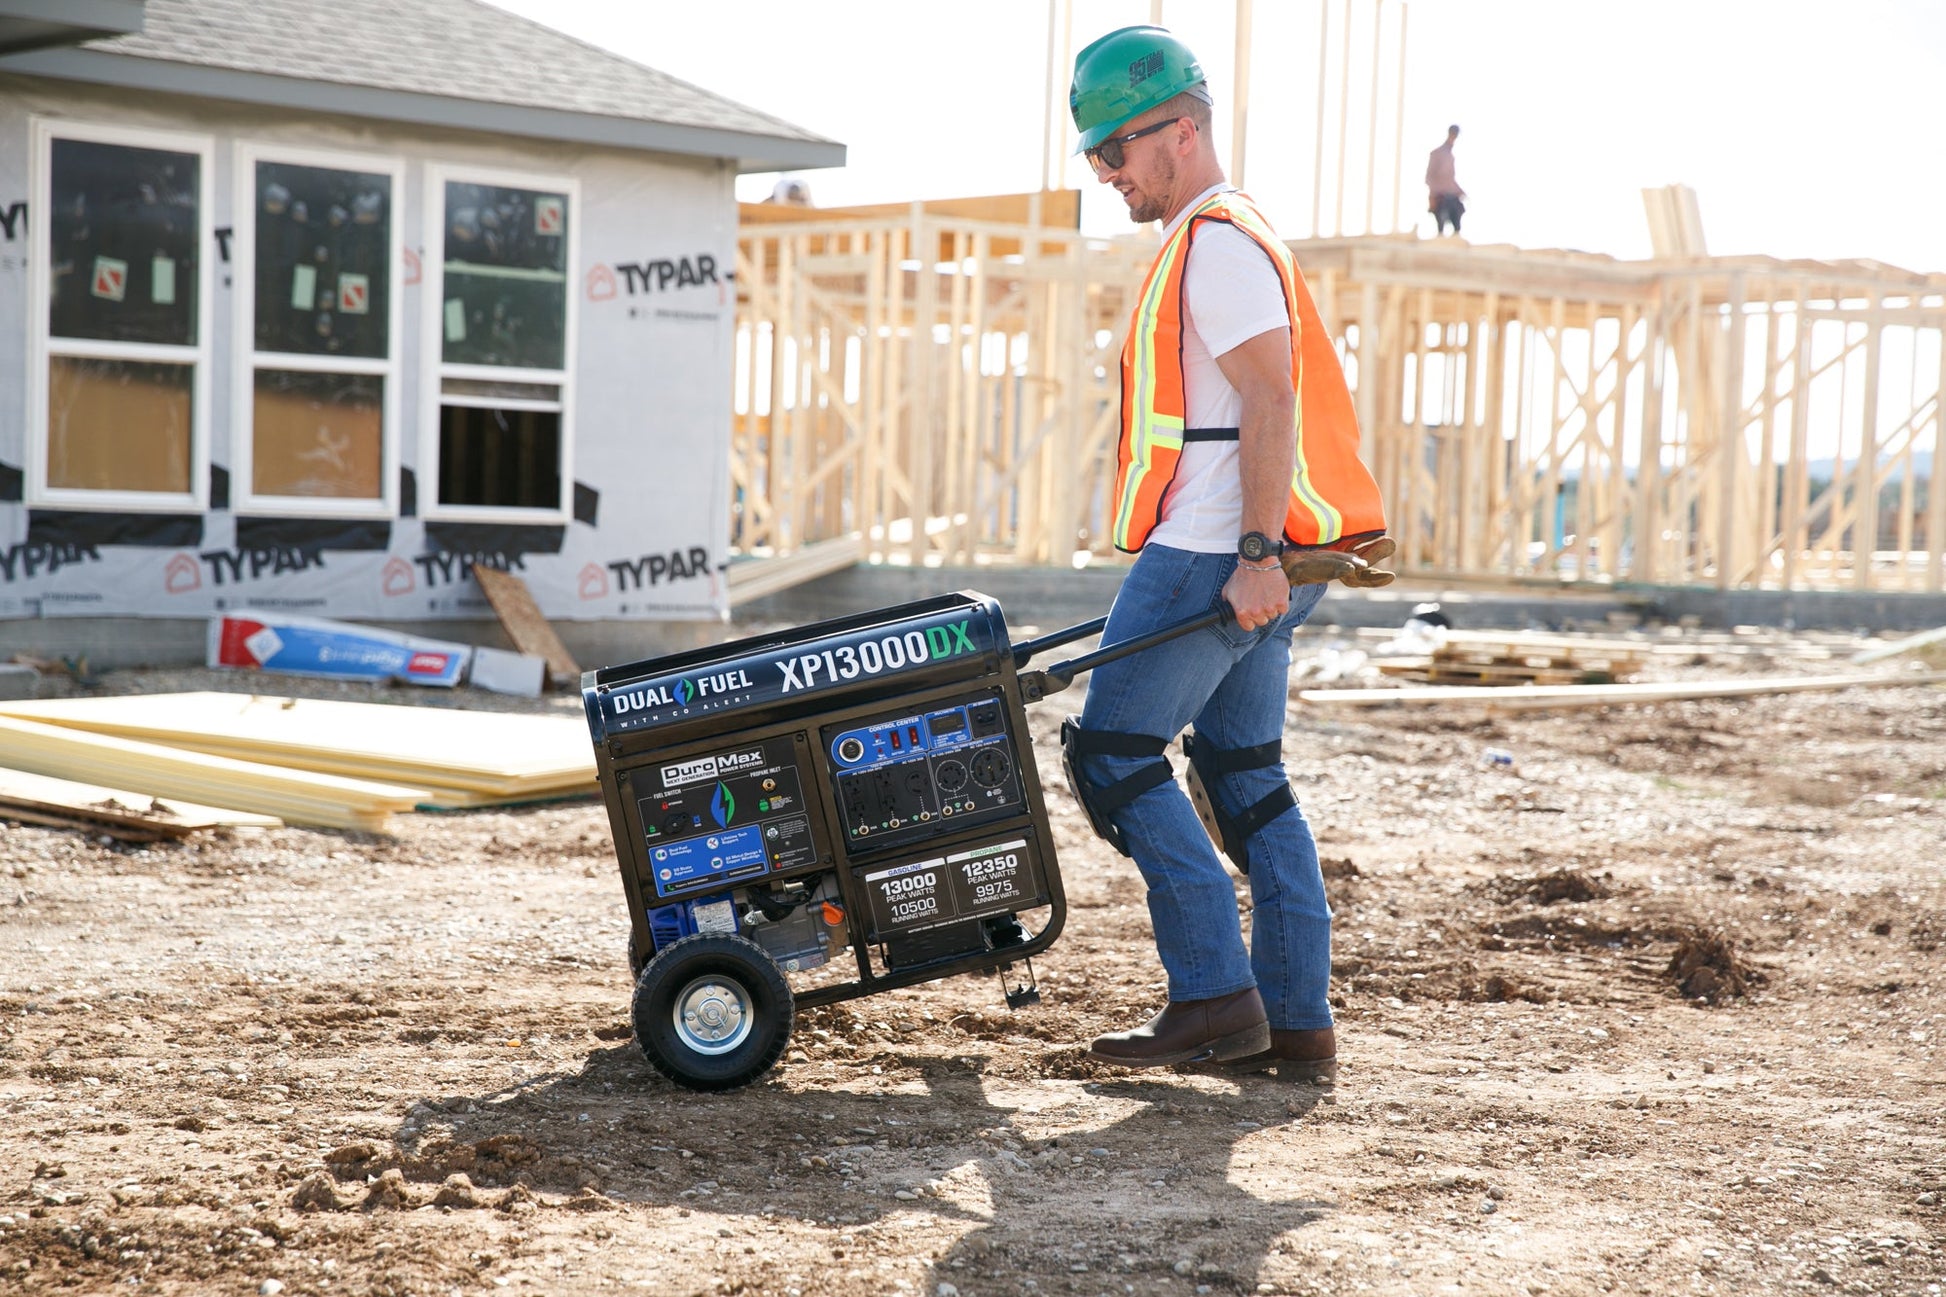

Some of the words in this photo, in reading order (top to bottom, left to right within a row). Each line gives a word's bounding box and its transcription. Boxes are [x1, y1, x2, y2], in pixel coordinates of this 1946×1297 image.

[616, 255, 719, 295] TYPAR
[608, 547, 711, 591] TYPAR
[775, 620, 976, 693] XP13000DX
[613, 686, 674, 715] DUAL
[697, 669, 753, 697] FUEL
[620, 714, 659, 729] WITH
[672, 708, 689, 717] CO
[703, 695, 751, 710] ALERT
[682, 771, 716, 782] GENERATION
[720, 766, 739, 774] POWER
[739, 760, 764, 770] SYSTEMS
[970, 846, 1003, 858] PROPANE
[888, 864, 922, 877] GASOLINE
[962, 854, 1018, 878] 12350
[880, 872, 937, 896] 13000
[967, 874, 988, 885] PEAK
[989, 868, 1017, 880] WATTS
[886, 893, 908, 903] PEAK
[908, 887, 935, 899] WATTS
[973, 895, 1000, 905] RUNNING
[1000, 890, 1020, 900] WATTS
[976, 879, 1013, 898] 9975
[891, 897, 936, 916] 10500
[891, 913, 918, 924] RUNNING
[918, 908, 939, 919] WATTS
